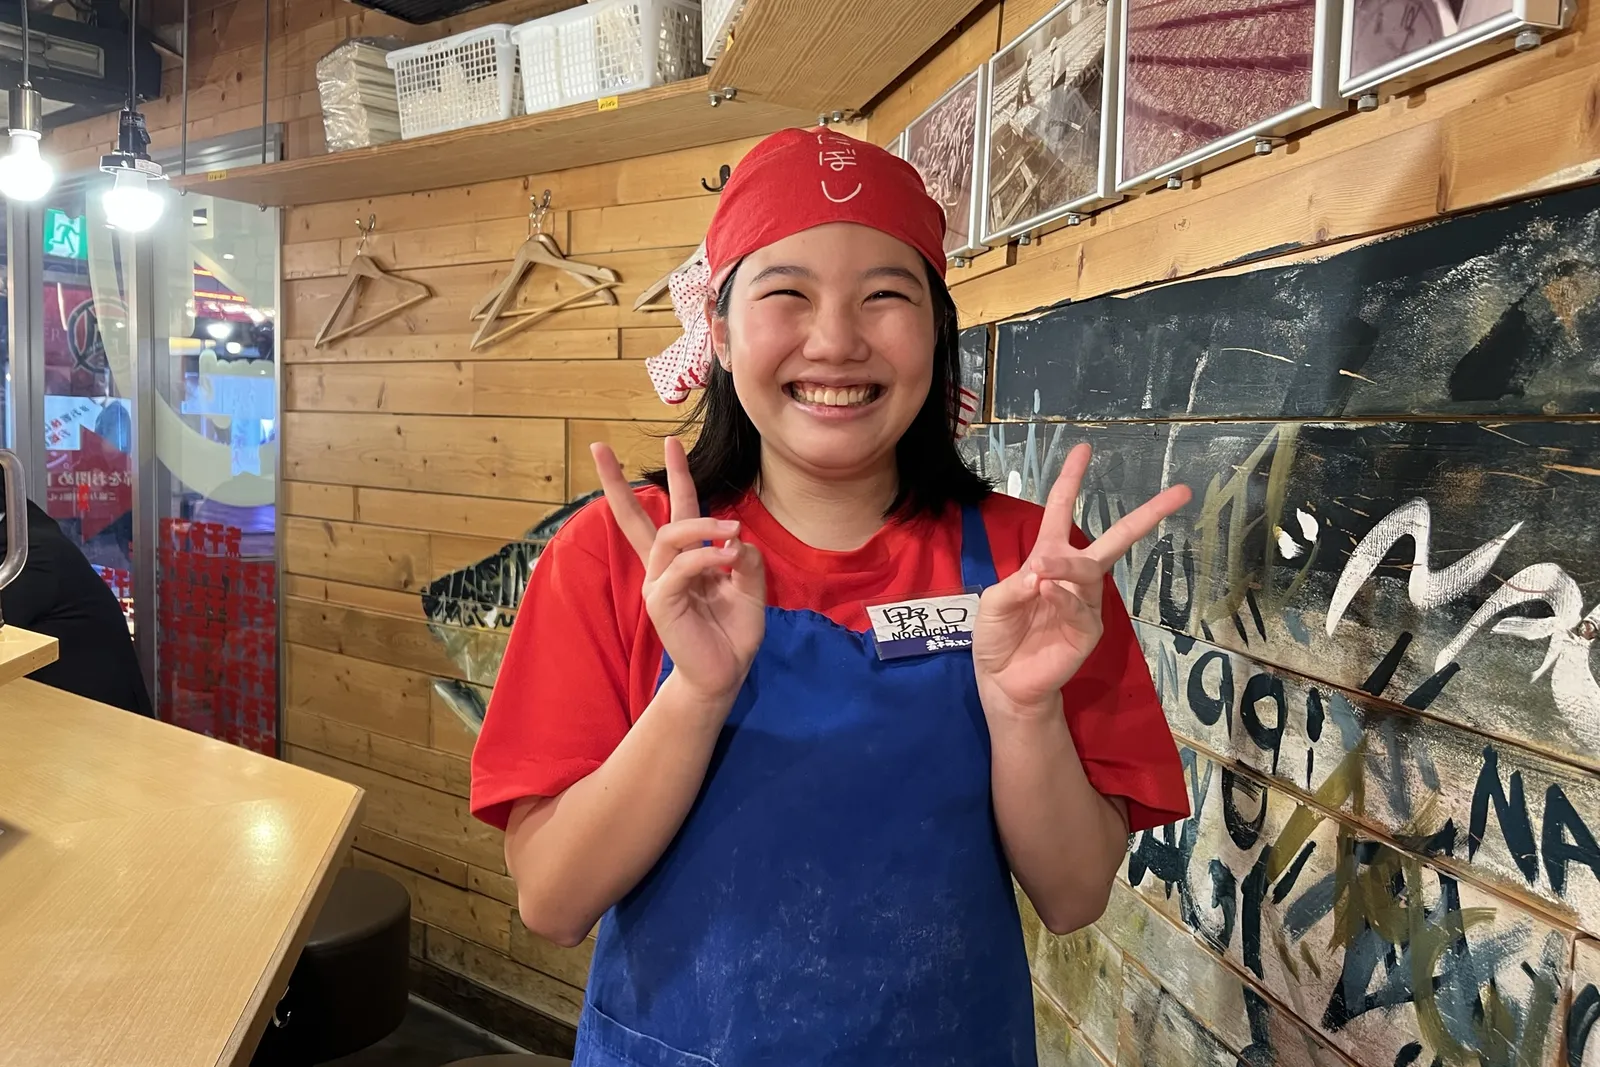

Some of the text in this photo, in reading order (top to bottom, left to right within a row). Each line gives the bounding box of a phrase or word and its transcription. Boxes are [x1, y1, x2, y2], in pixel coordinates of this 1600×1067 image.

[817, 133, 862, 203] にぼし
[882, 606, 968, 635] 野口
